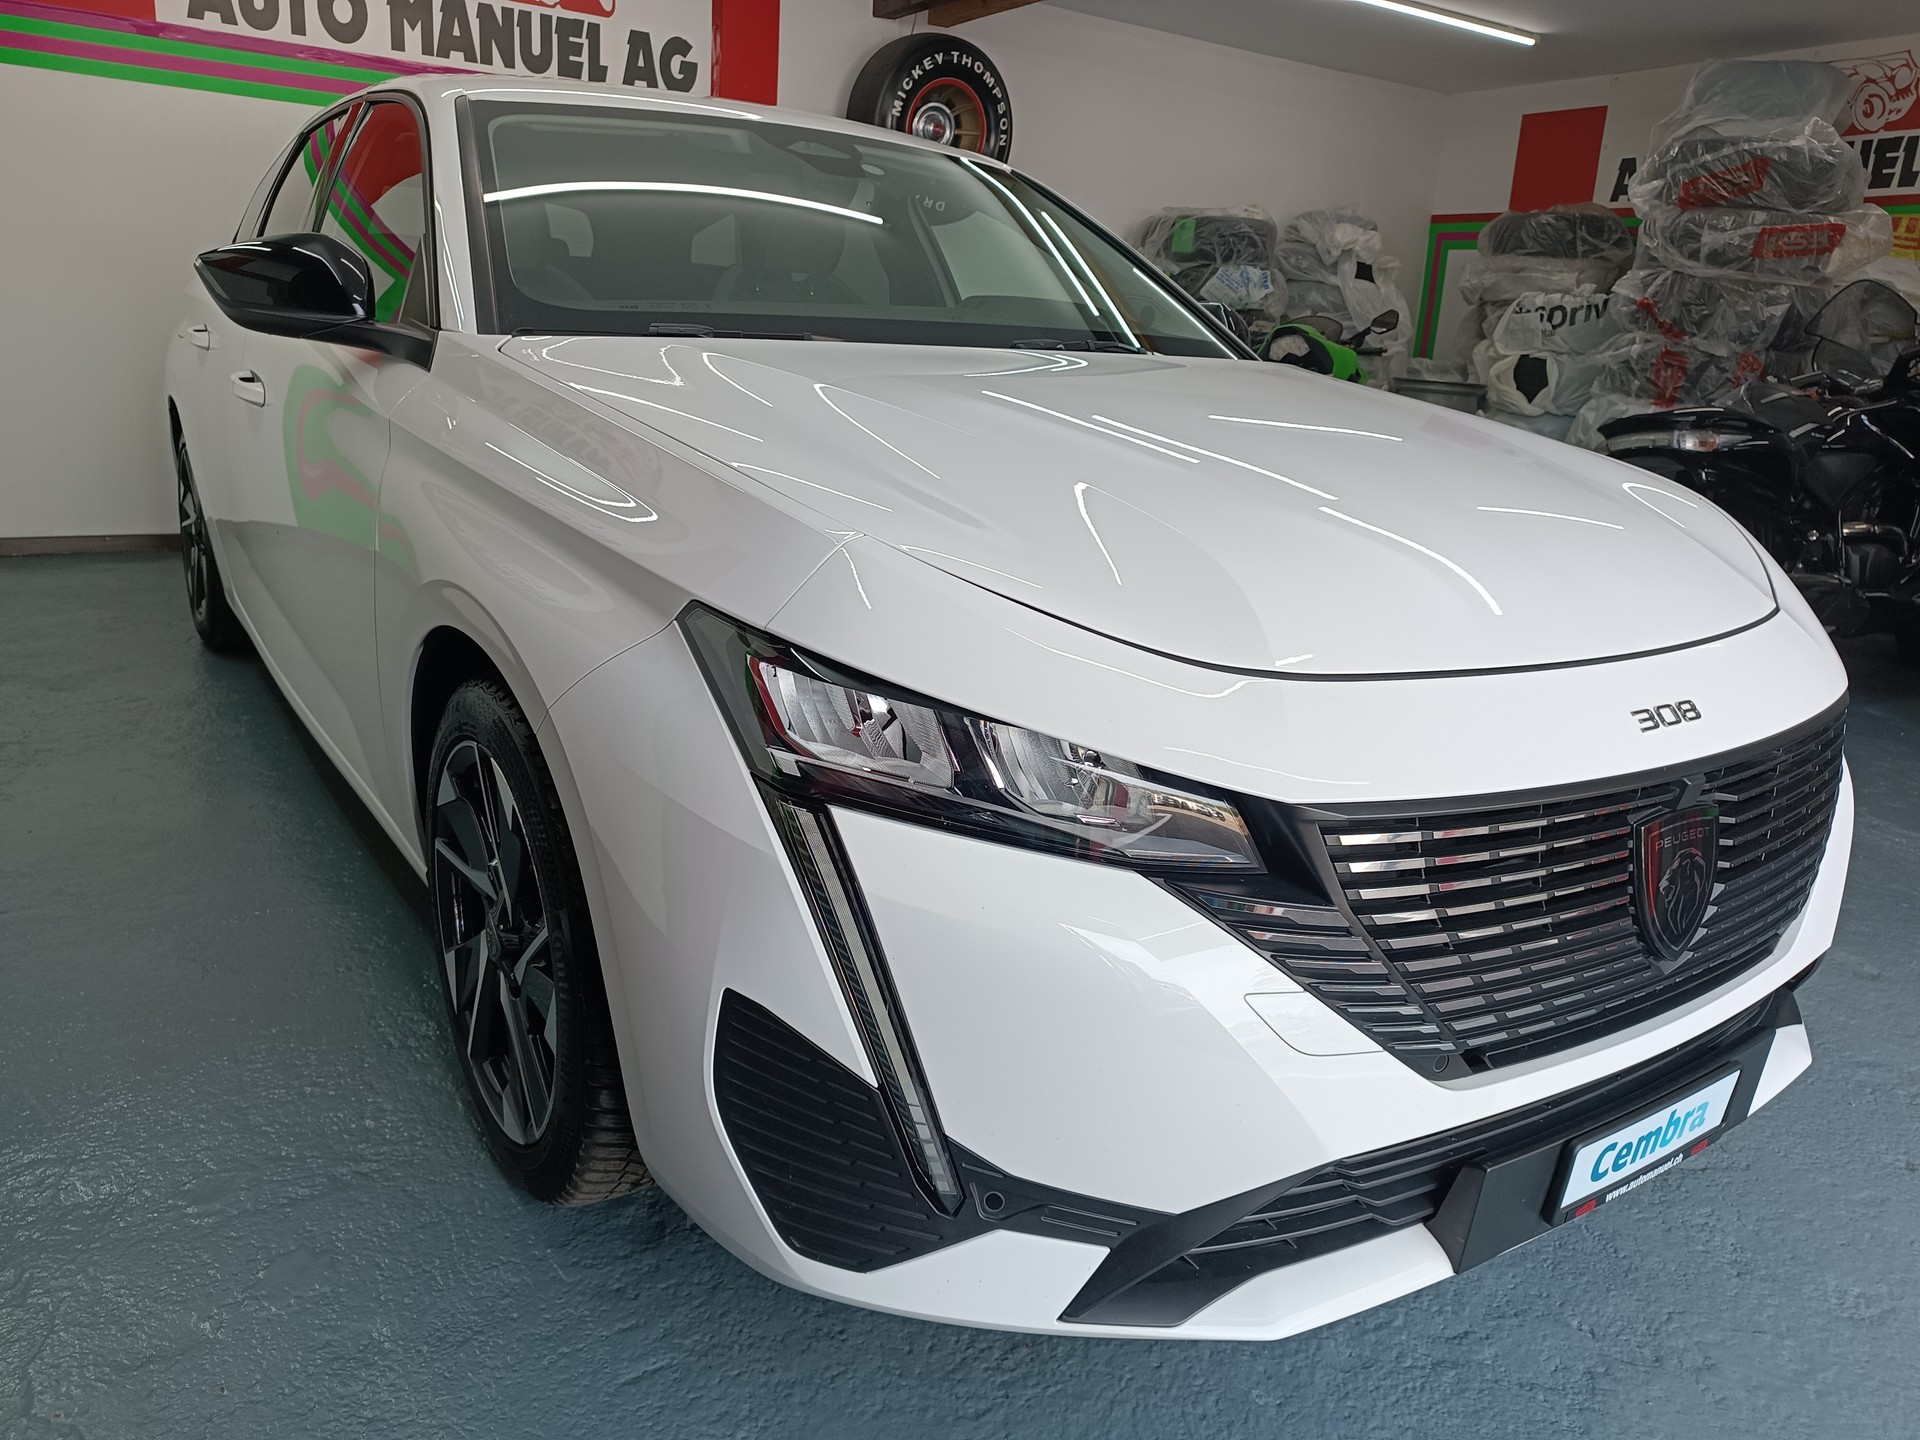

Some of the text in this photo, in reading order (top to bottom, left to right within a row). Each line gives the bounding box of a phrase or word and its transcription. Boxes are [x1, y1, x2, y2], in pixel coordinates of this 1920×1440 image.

[386, 0, 608, 83] MANUEL
[622, 29, 699, 93] AG
[891, 51, 1009, 146] MICKEY THOMPSON
[1630, 699, 1702, 734] 308
[1655, 826, 1711, 852] PEUGEOT
[1590, 1101, 1710, 1183] Cembra
[1605, 1152, 1685, 1203] www.automanuel.ch
